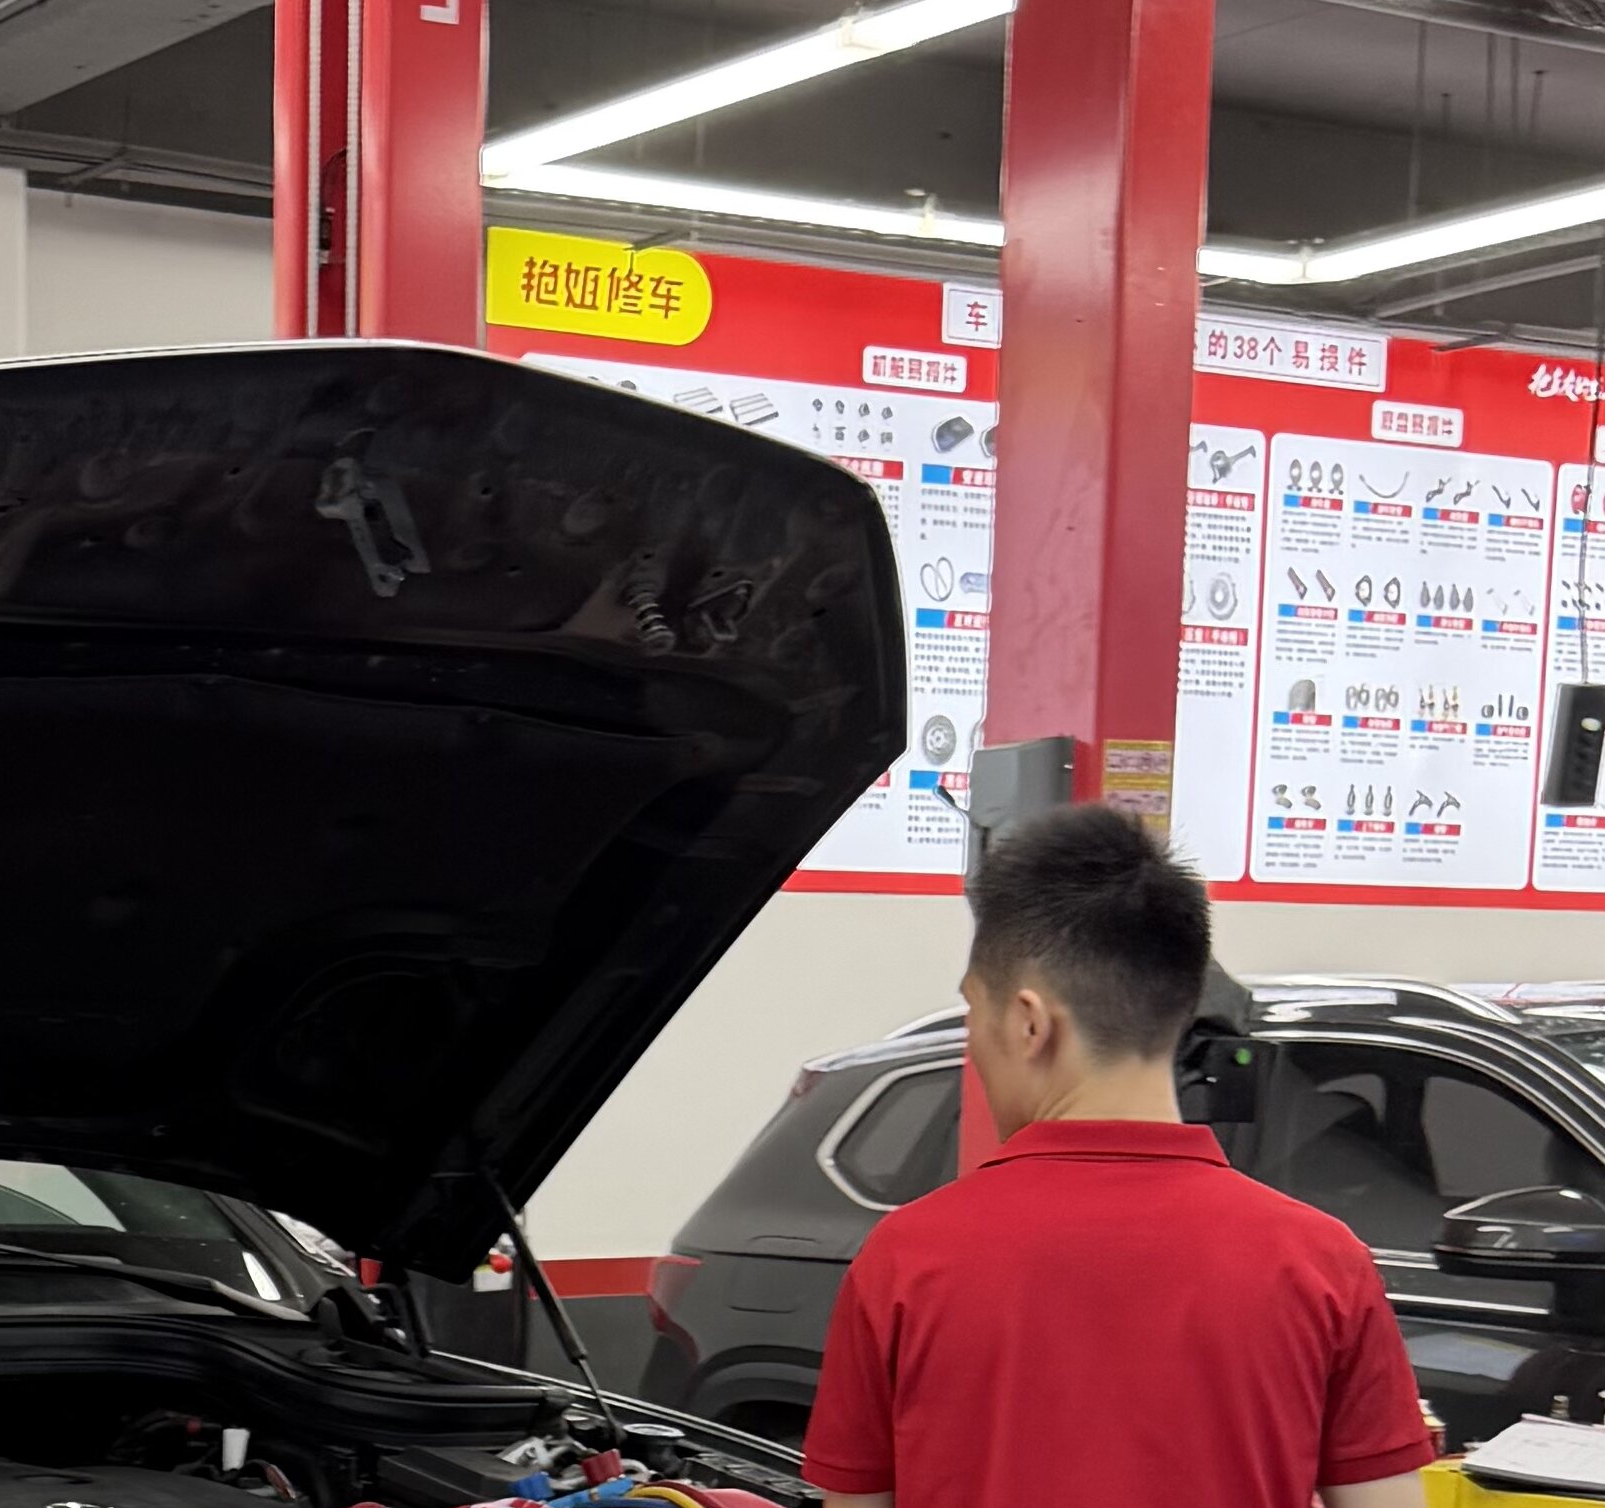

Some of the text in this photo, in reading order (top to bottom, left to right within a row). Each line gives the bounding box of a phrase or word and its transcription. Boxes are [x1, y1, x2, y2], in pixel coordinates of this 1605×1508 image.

[521, 256, 684, 320] 艳姐修车
[1194, 328, 1367, 376] 的38个易损件
